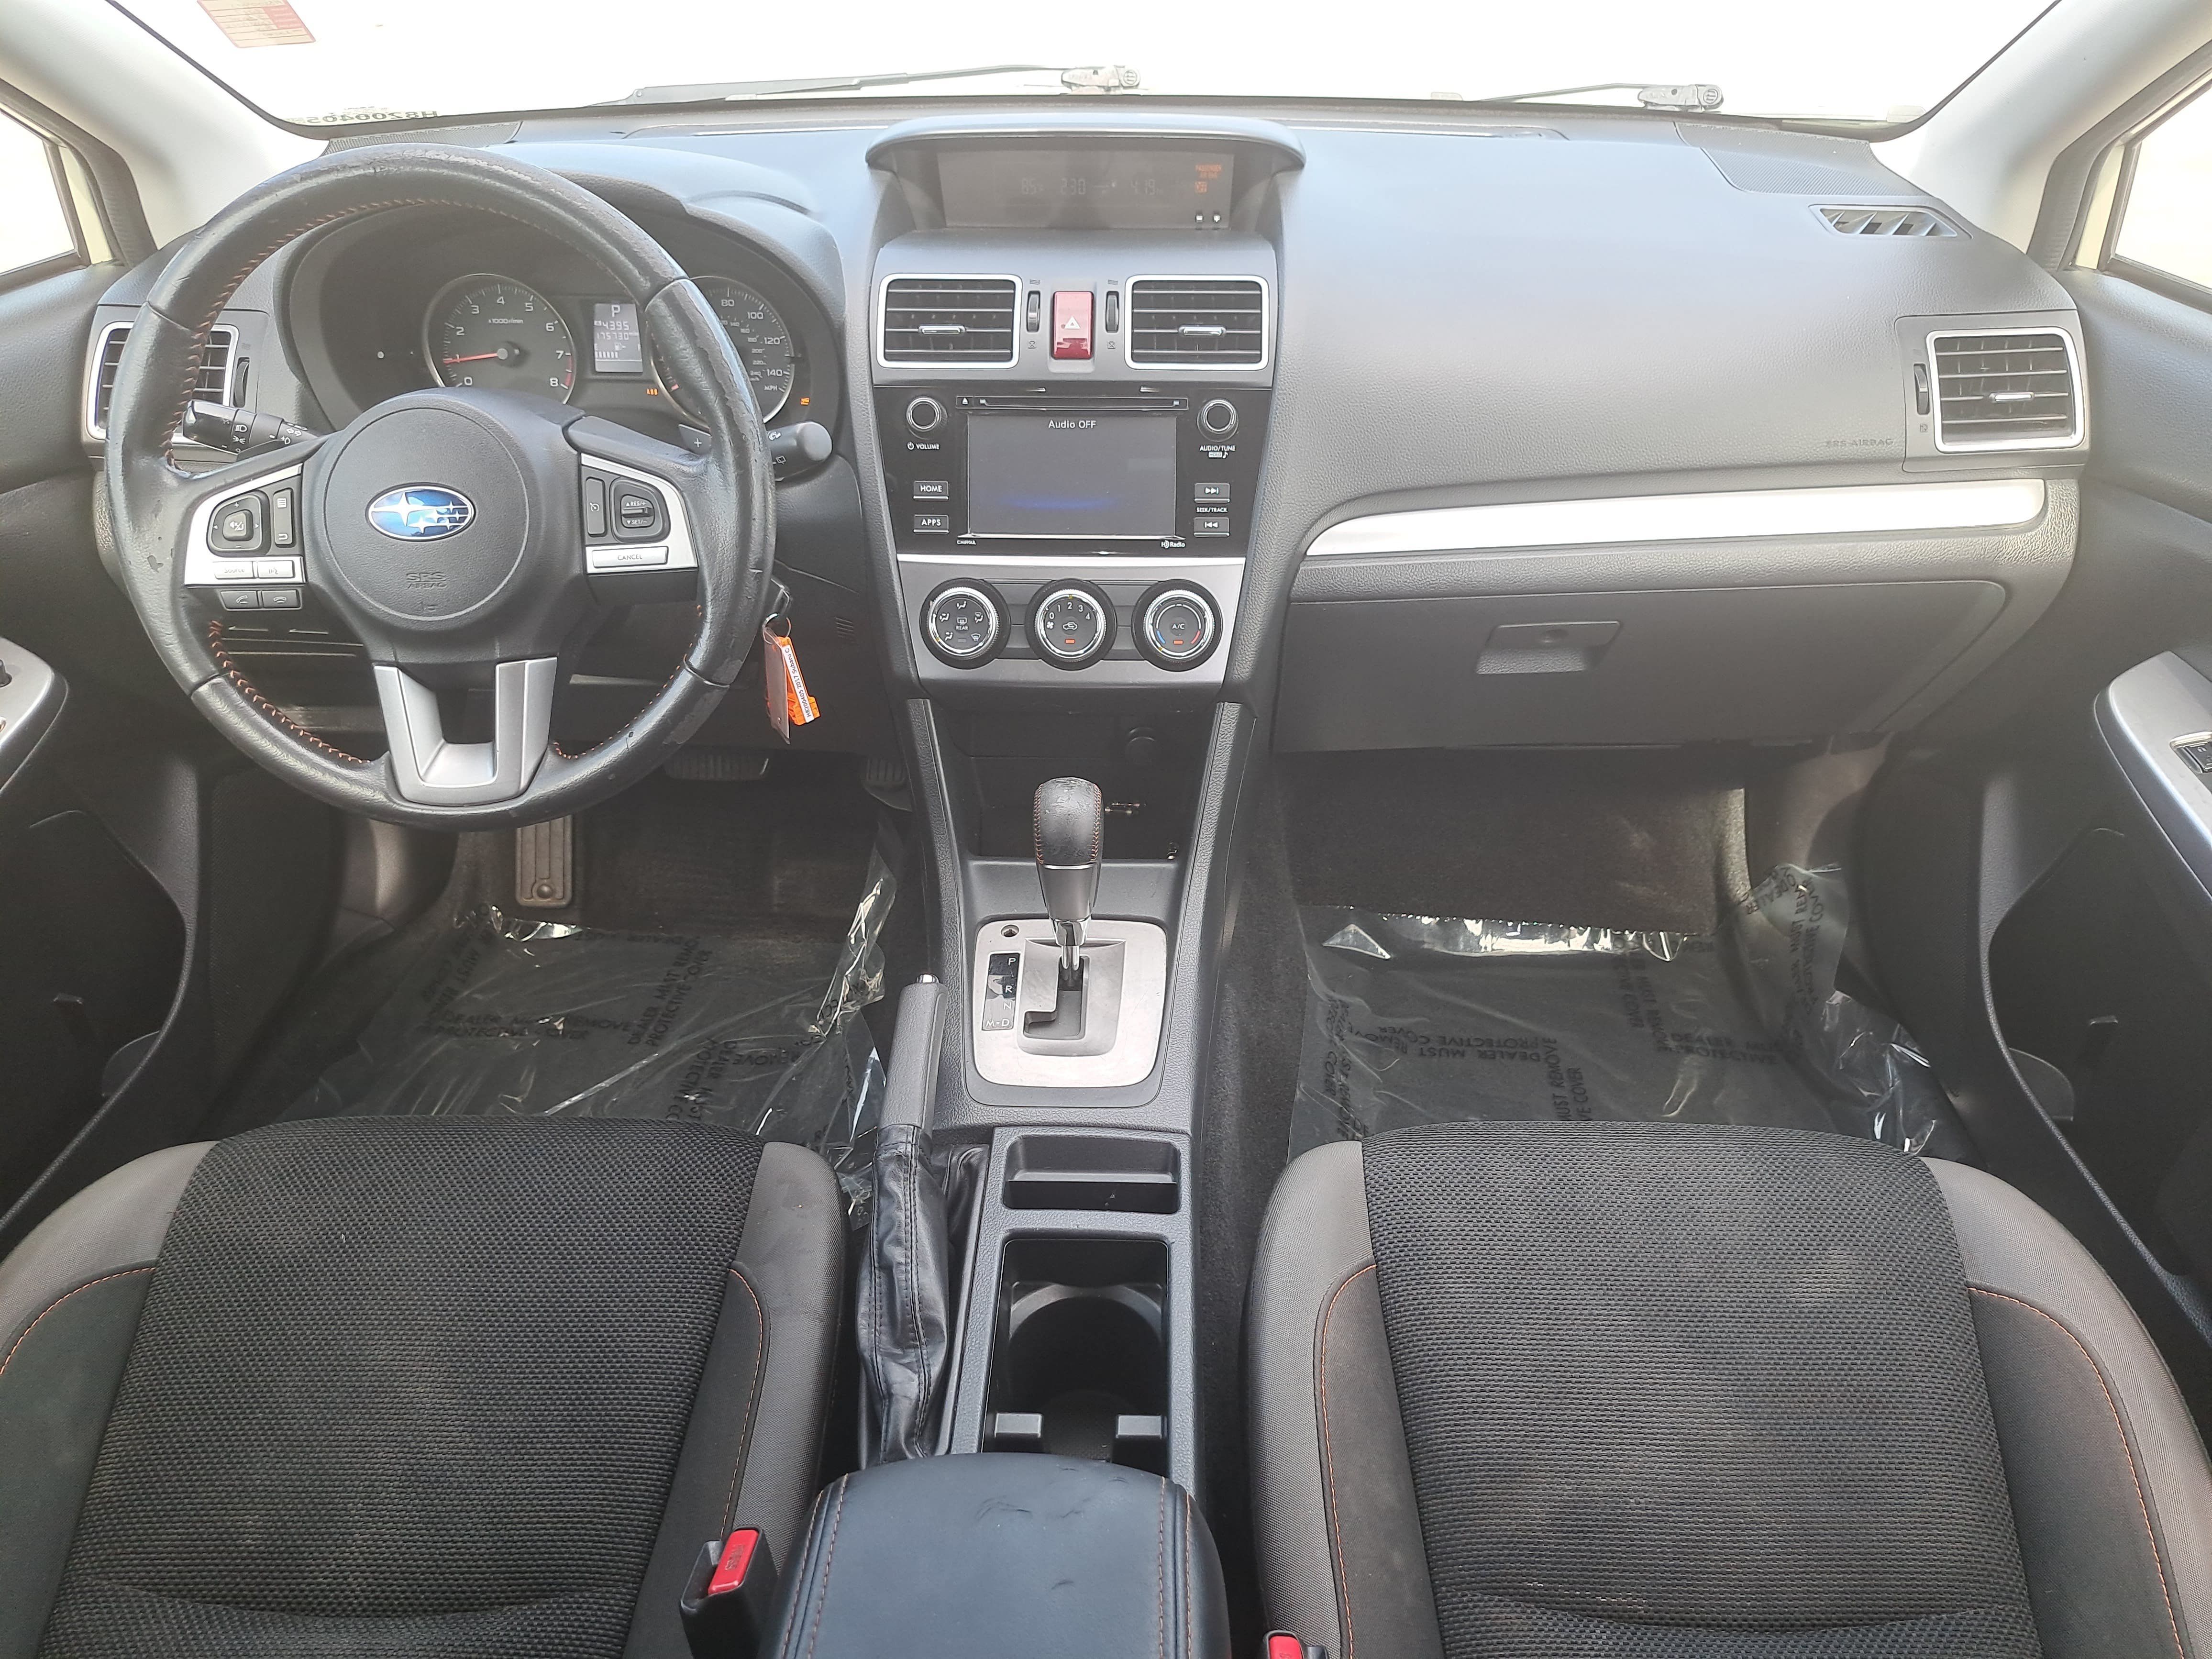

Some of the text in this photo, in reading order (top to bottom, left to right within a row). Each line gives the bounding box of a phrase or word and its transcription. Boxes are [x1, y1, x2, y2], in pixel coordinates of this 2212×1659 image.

[497, 296, 505, 305] 4
[471, 305, 479, 314] 3
[525, 302, 533, 311] 5
[611, 305, 620, 317] P
[456, 326, 465, 335] 2
[546, 322, 554, 332] 6
[556, 350, 564, 359] 7
[464, 376, 473, 386] 0
[550, 377, 559, 387] 8
[1049, 420, 1096, 429] Audio OFF
[406, 572, 446, 582] SRS
[788, 654, 797, 674] Subaru
[794, 675, 802, 689] 2017
[799, 690, 812, 718] H8200405
[1007, 958, 1016, 966] P
[1378, 1026, 1539, 1050] PROTECTIVE COVER
[1418, 1046, 1466, 1059] MUST
[1478, 1049, 1541, 1062] DEALER
[1542, 1037, 1565, 1089] REMOVE
[1566, 1067, 1588, 1104] COVER
